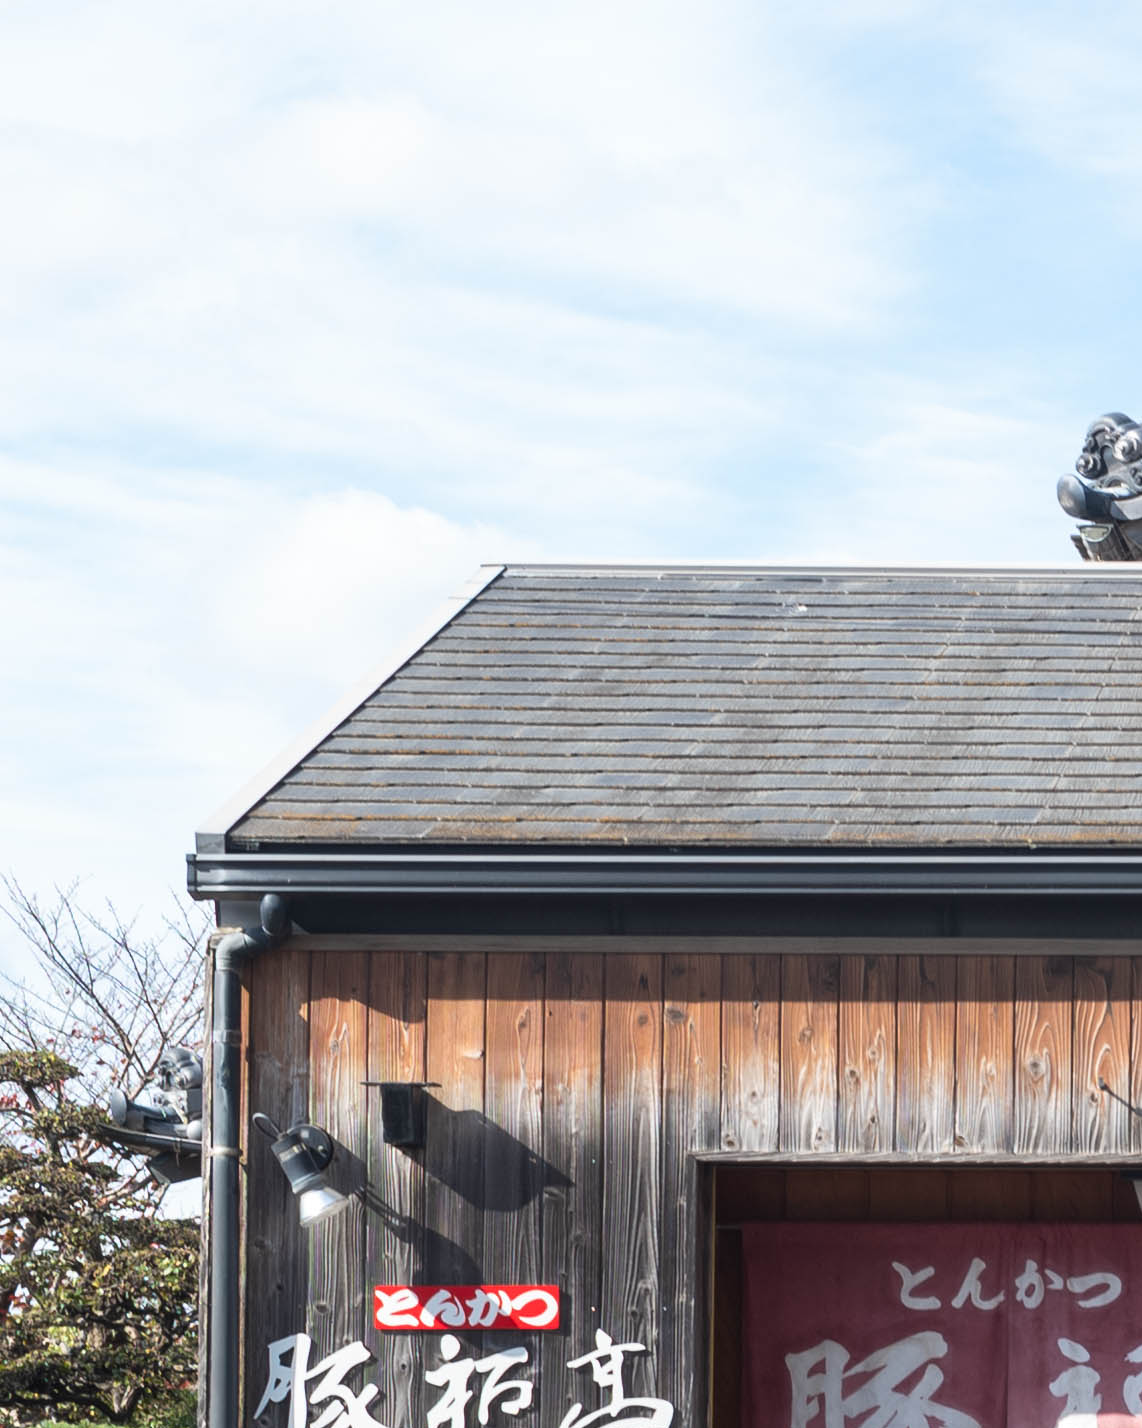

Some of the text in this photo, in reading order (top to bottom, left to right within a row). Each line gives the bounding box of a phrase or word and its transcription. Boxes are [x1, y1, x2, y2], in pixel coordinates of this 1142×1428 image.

[891, 1258, 1122, 1311] とんかつ
[375, 1289, 559, 1327] とんかつ
